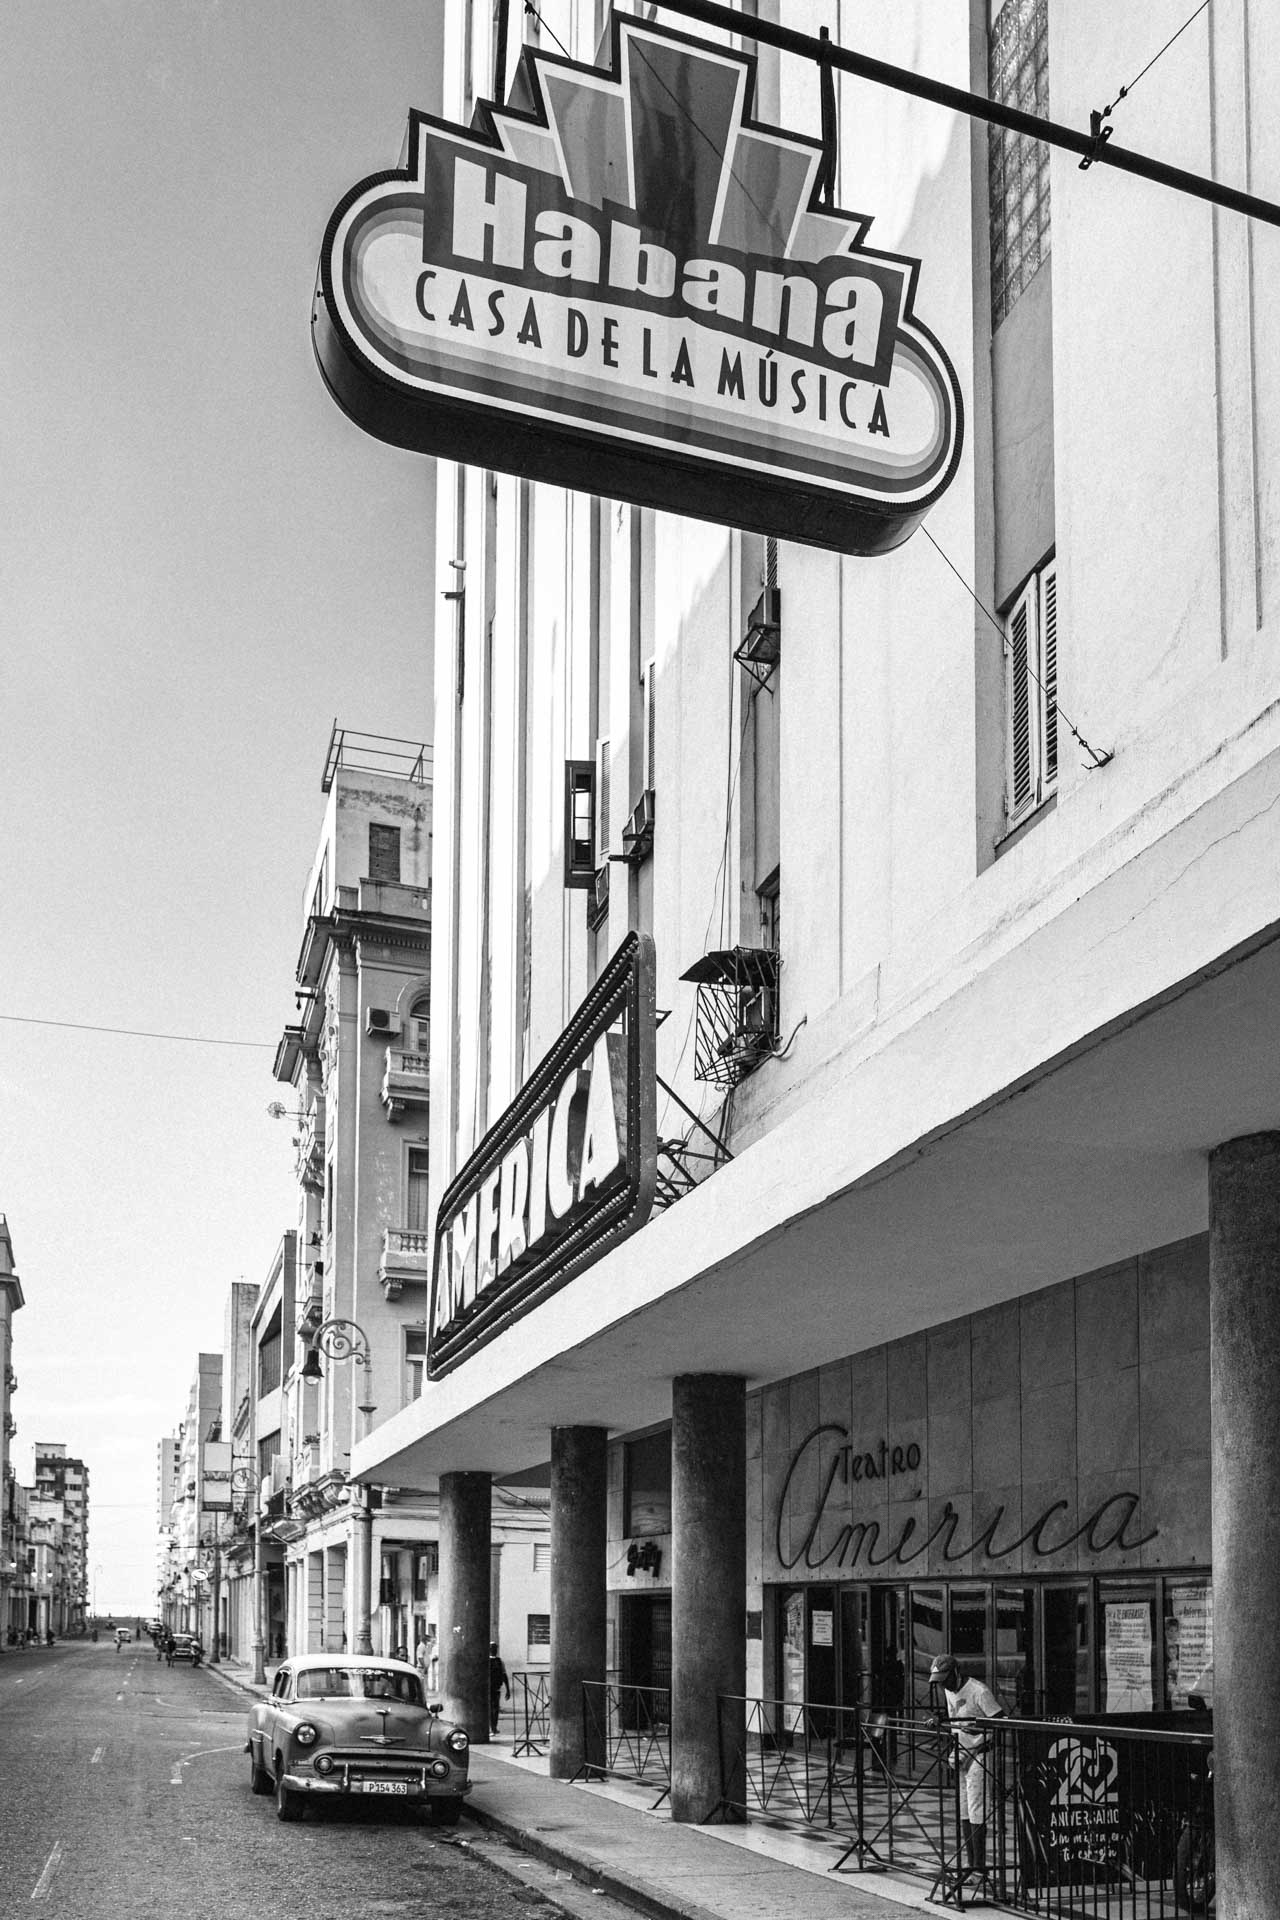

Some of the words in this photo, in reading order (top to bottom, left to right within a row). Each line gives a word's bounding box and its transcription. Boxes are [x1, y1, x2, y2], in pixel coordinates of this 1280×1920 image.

[452, 156, 884, 367] Habana
[416, 270, 542, 349] CASA
[567, 307, 619, 368] DE
[643, 327, 695, 388] LA
[717, 349, 890, 438] MÚSICA
[776, 1424, 1159, 1570] América
[1048, 1737, 1119, 1805] 22
